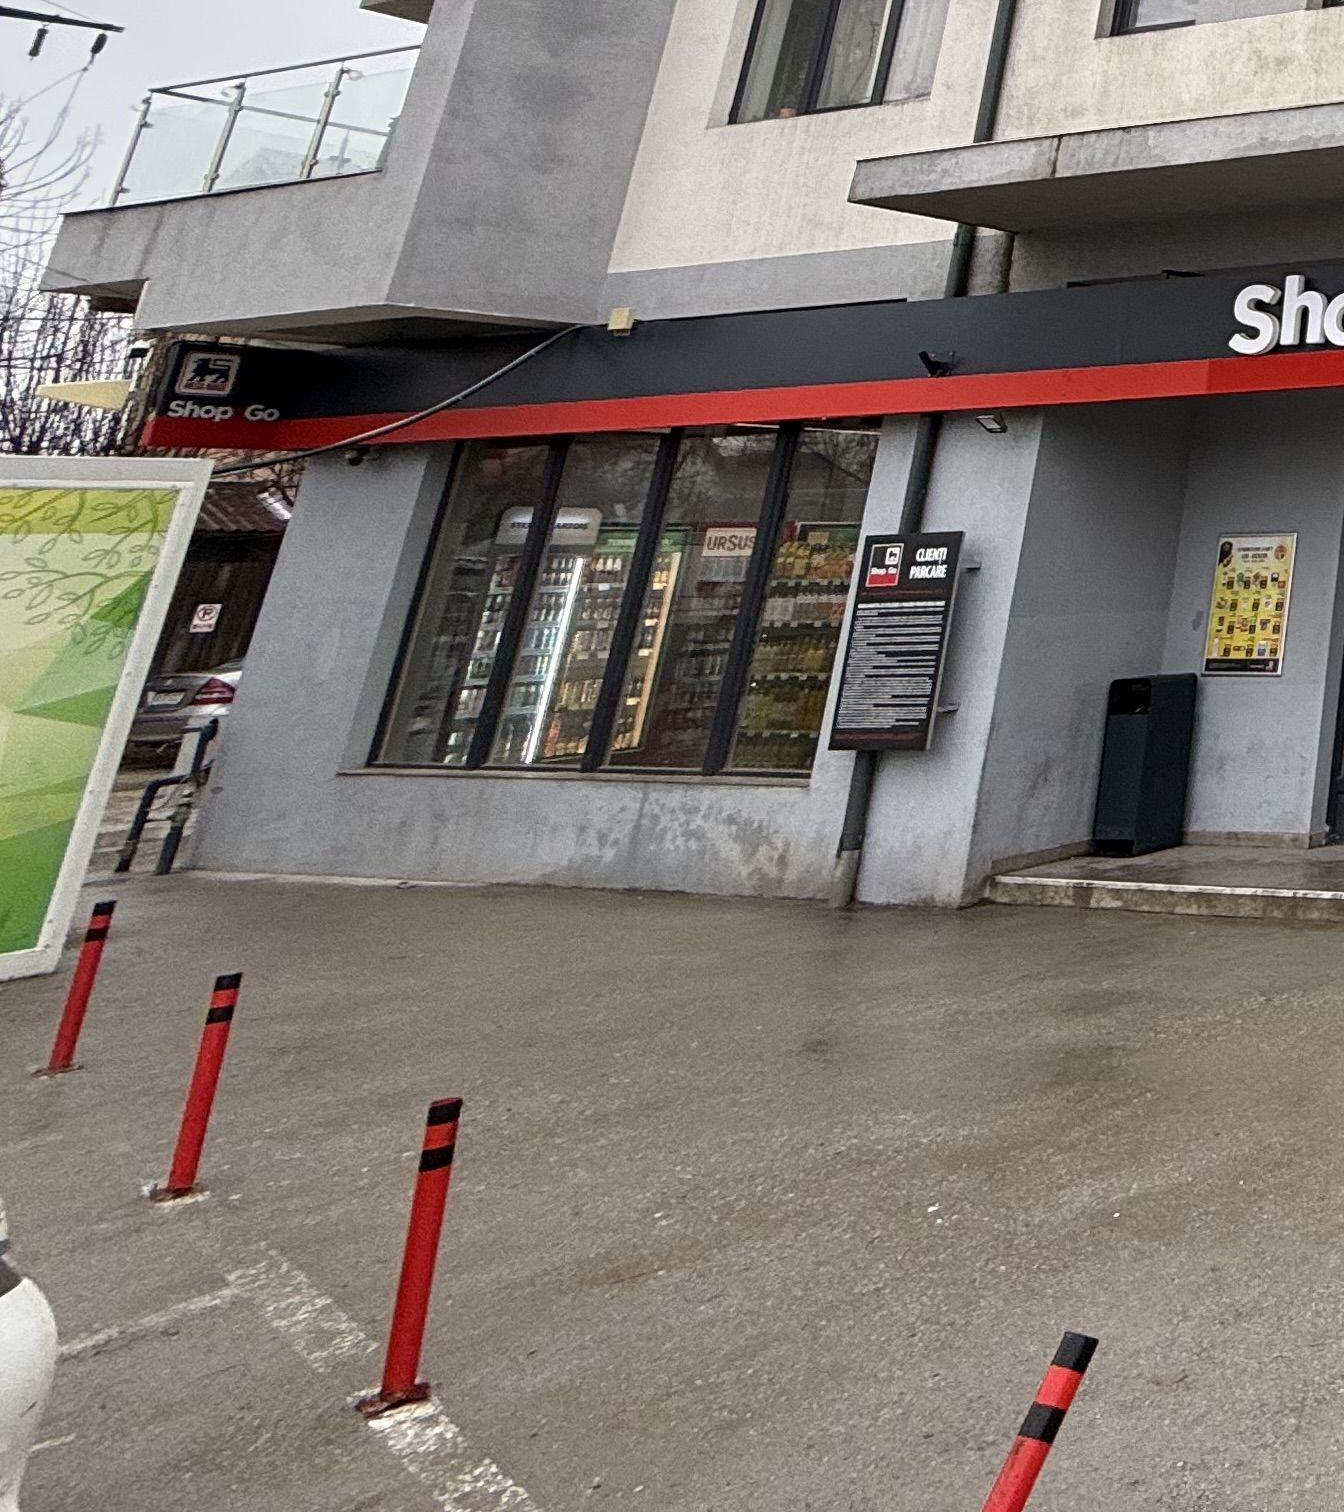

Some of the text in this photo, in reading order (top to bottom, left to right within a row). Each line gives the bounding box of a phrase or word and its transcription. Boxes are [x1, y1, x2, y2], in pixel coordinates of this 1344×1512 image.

[167, 400, 280, 422] Shop Go
[706, 534, 756, 552] URSUS
[909, 565, 947, 579] PARCARE
